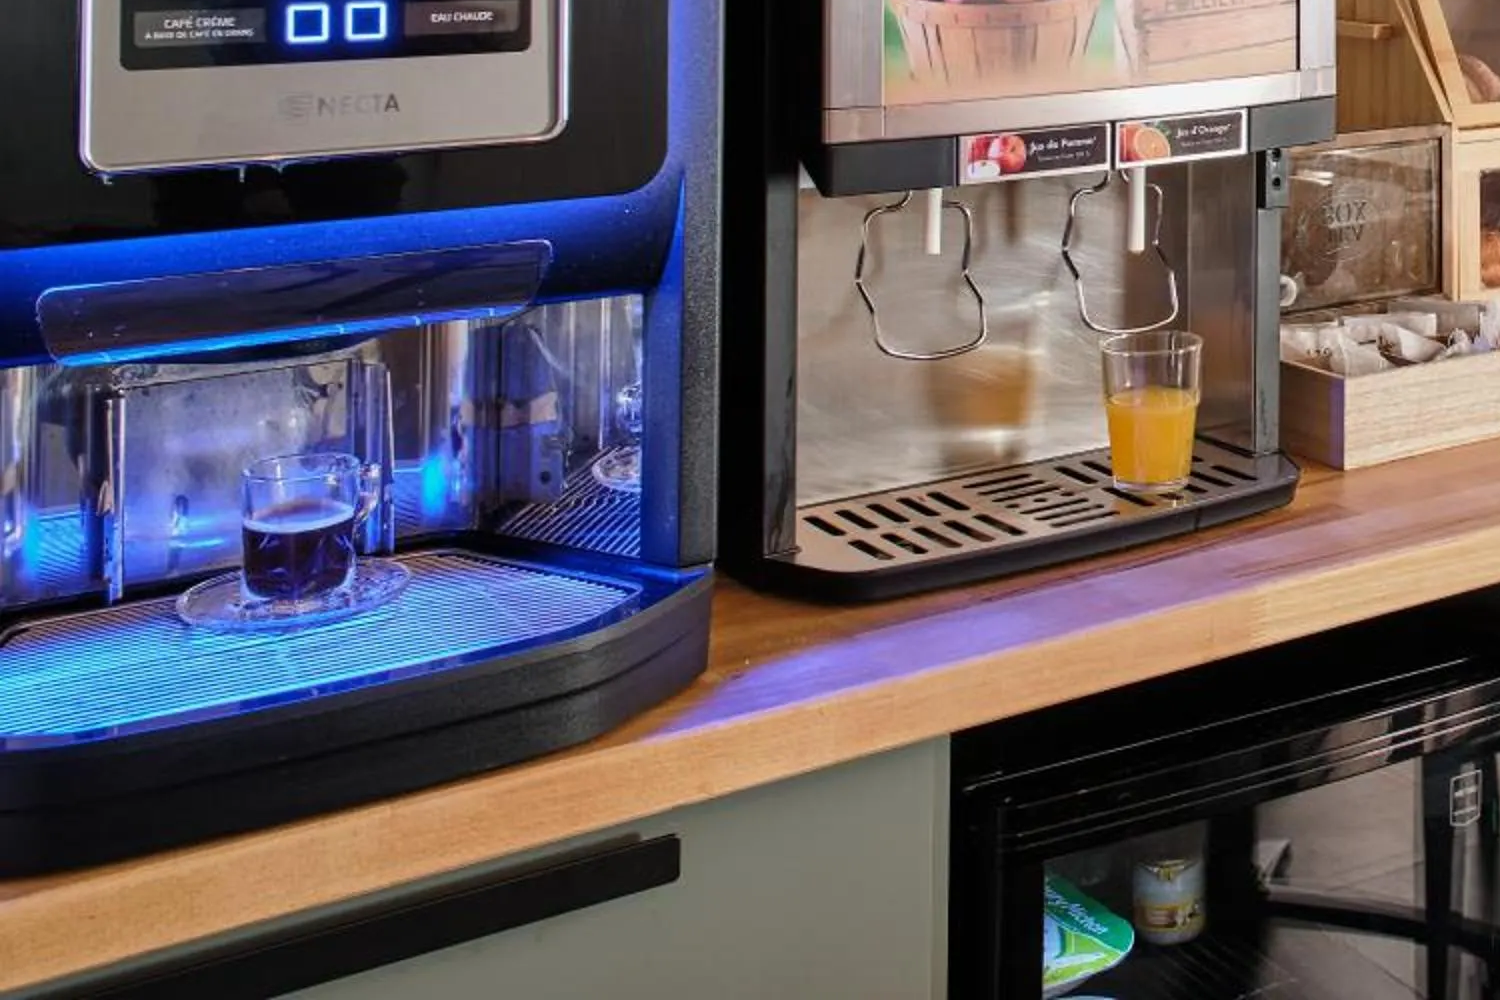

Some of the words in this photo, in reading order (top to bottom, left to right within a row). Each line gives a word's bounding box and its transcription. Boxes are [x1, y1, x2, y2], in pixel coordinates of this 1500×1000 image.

[163, 16, 194, 29] CAFÉ
[453, 11, 495, 22] CHAUDE
[317, 92, 400, 117] NECTA
